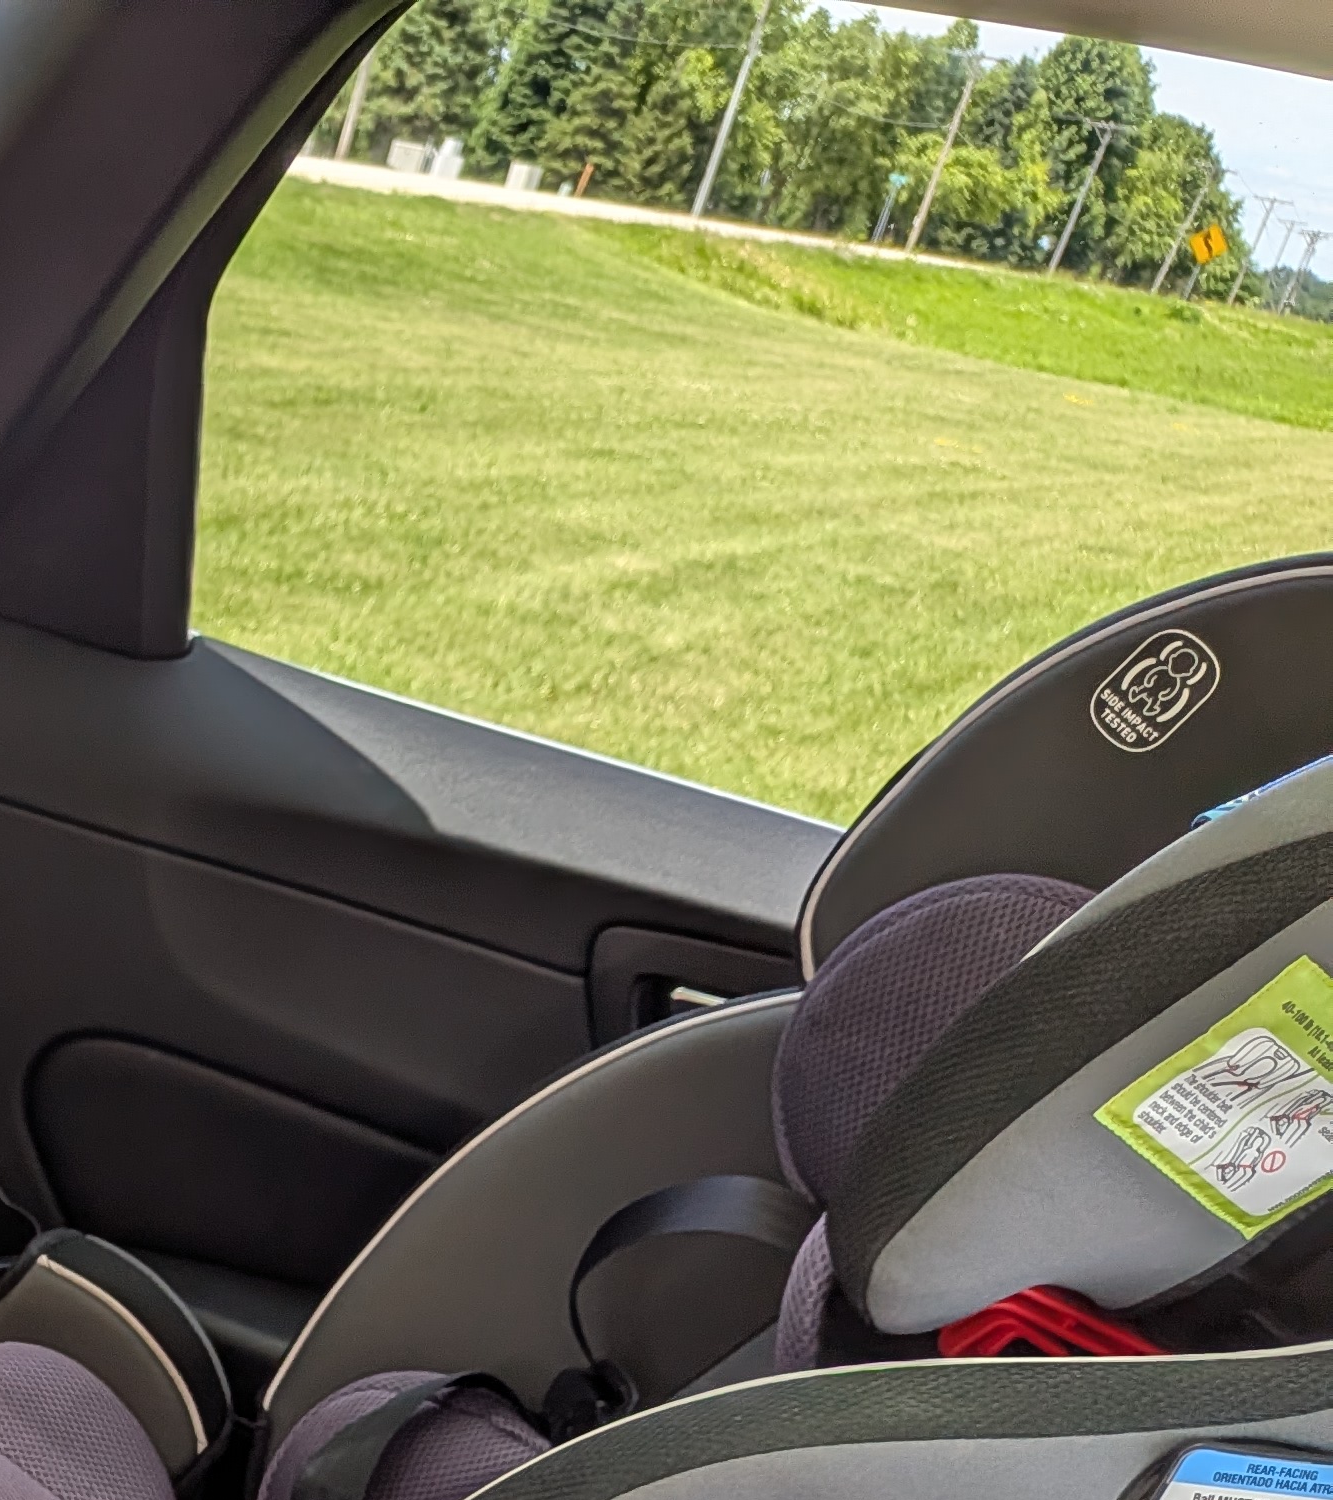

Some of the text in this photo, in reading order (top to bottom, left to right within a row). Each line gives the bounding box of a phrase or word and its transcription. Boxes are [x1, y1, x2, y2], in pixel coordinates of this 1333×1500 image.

[1097, 706, 1140, 744] TESTED
[1098, 686, 1161, 743] SIDE IMPACT
[1159, 1088, 1217, 1140] between the child's
[1171, 1079, 1226, 1129] should be centered
[1194, 1079, 1221, 1106] shoulder
[1217, 1099, 1232, 1115] belt
[1212, 1471, 1307, 1492] ORIENTADO HACIA
[1246, 1462, 1318, 1481] REAR-FACING
